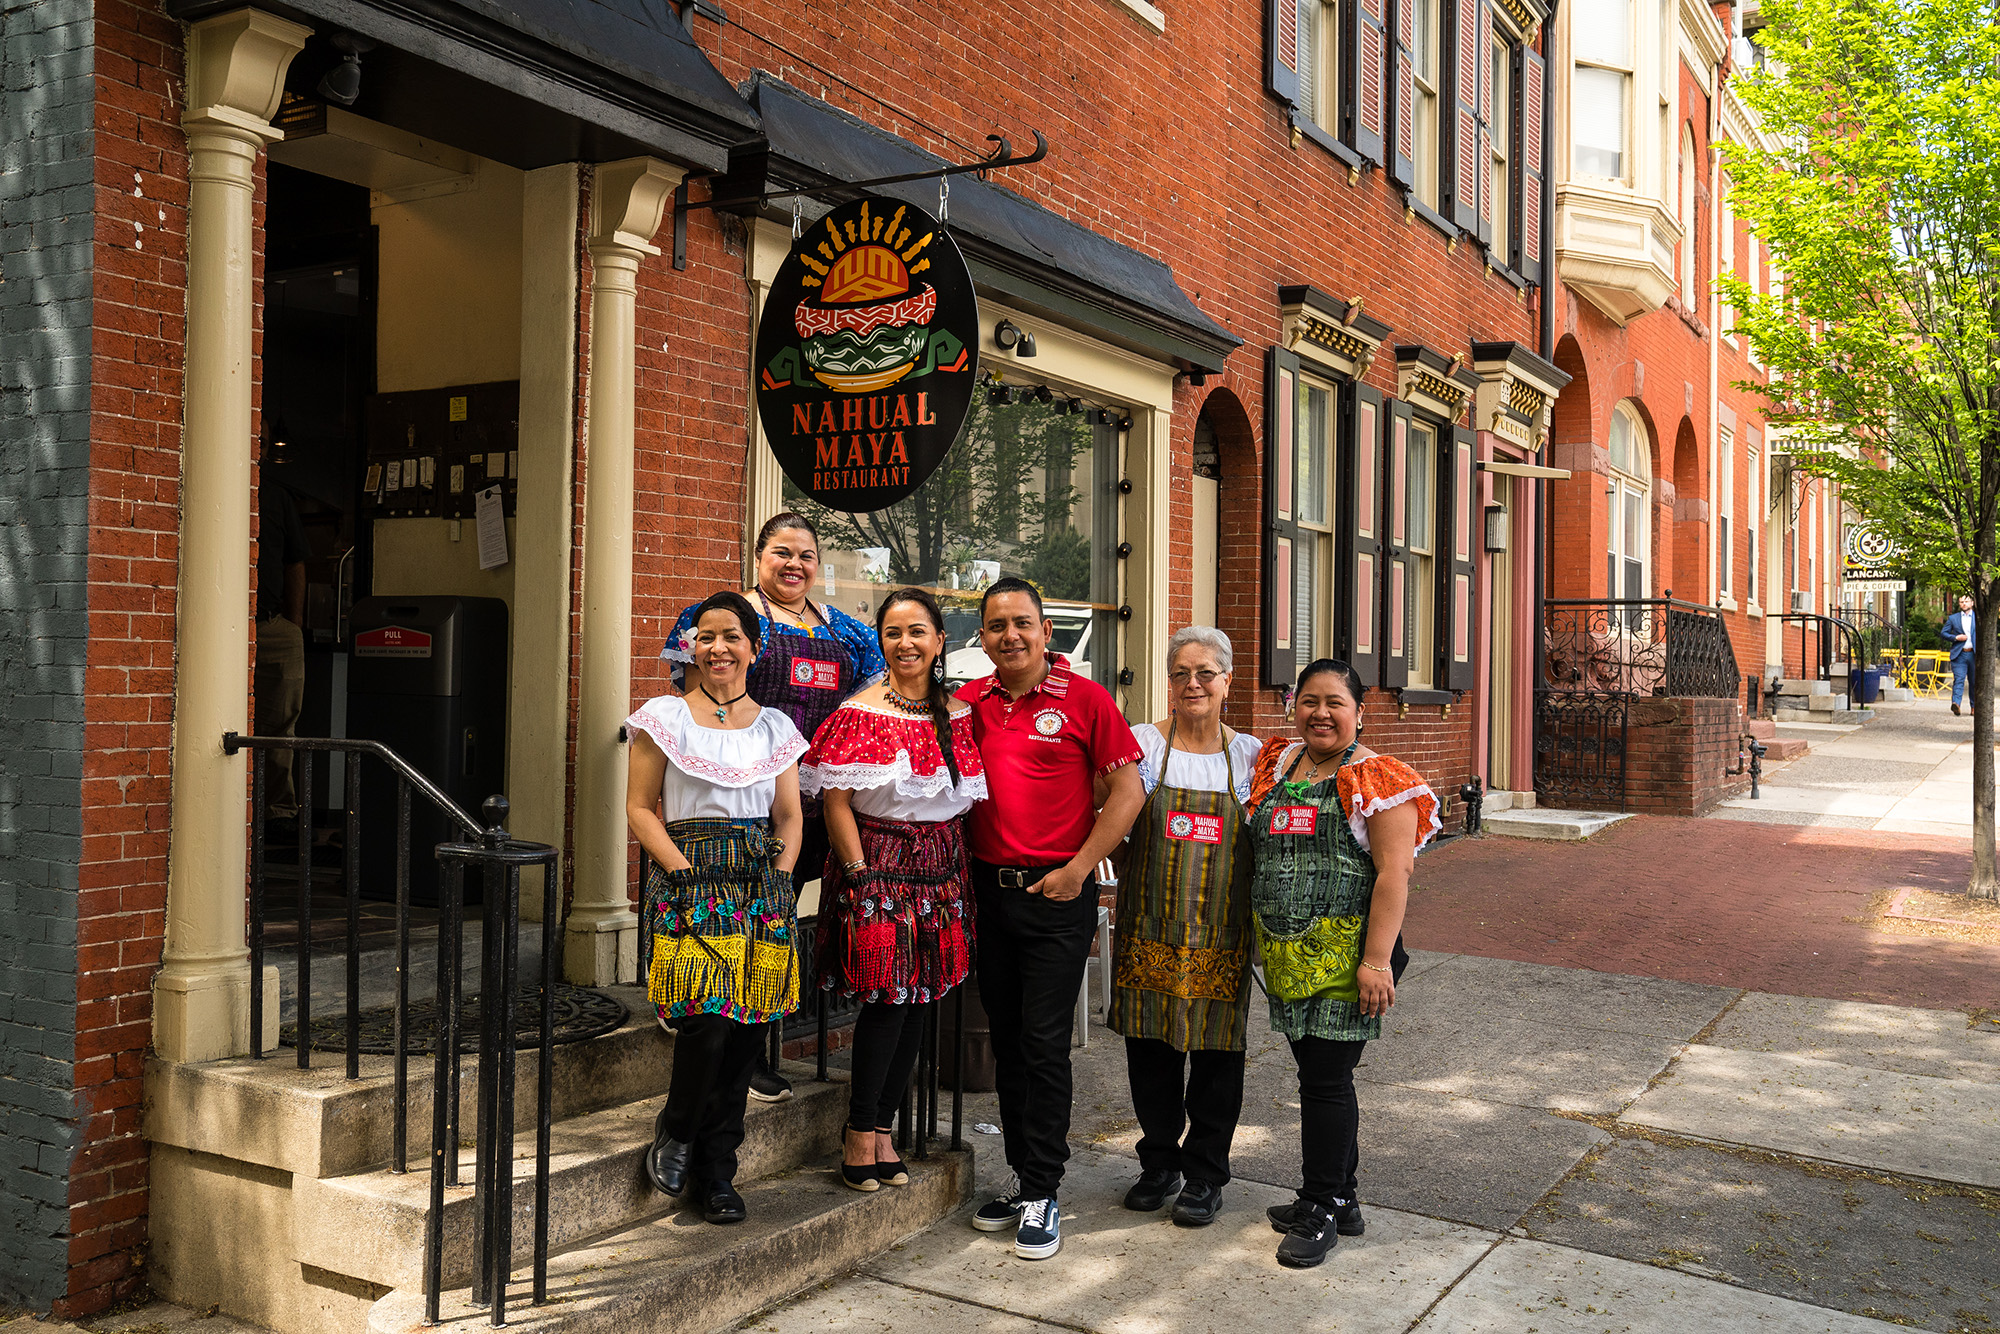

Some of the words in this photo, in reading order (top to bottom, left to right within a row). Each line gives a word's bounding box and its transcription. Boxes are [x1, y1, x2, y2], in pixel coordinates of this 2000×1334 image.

[792, 391, 937, 435] NAHUAL
[814, 431, 910, 469] MAYA
[813, 466, 910, 491] RESTAURANT
[385, 630, 402, 639] PULL
[815, 663, 836, 674] NAHUAL
[1028, 734, 1061, 743] RESTAURANTE
[1291, 809, 1313, 818] NAHUAL
[1194, 816, 1219, 828] NAHUAL
